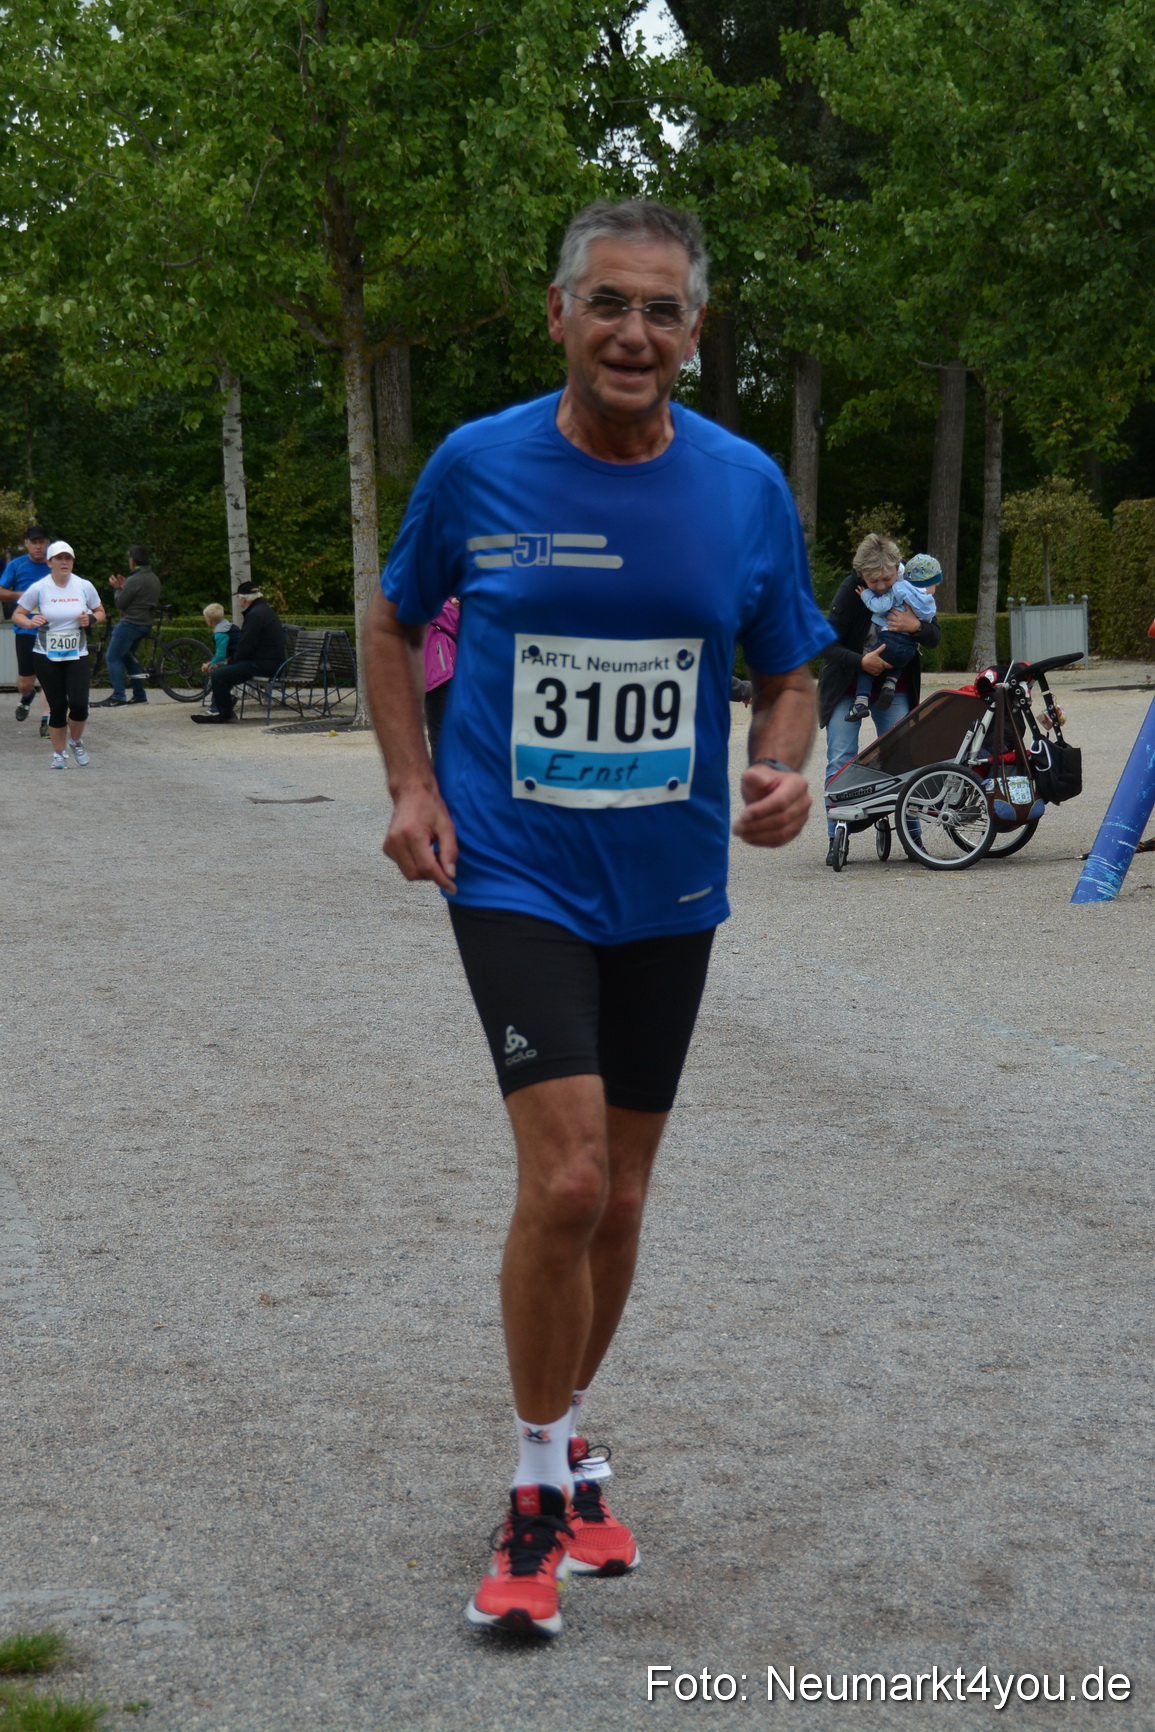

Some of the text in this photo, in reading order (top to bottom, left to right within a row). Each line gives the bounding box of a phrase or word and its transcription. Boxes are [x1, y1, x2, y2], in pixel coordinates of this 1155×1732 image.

[50, 637, 77, 649] 2400
[521, 649, 669, 673] PARTL Neumarkt
[534, 677, 681, 743] 3109
[545, 753, 639, 781] Ernst
